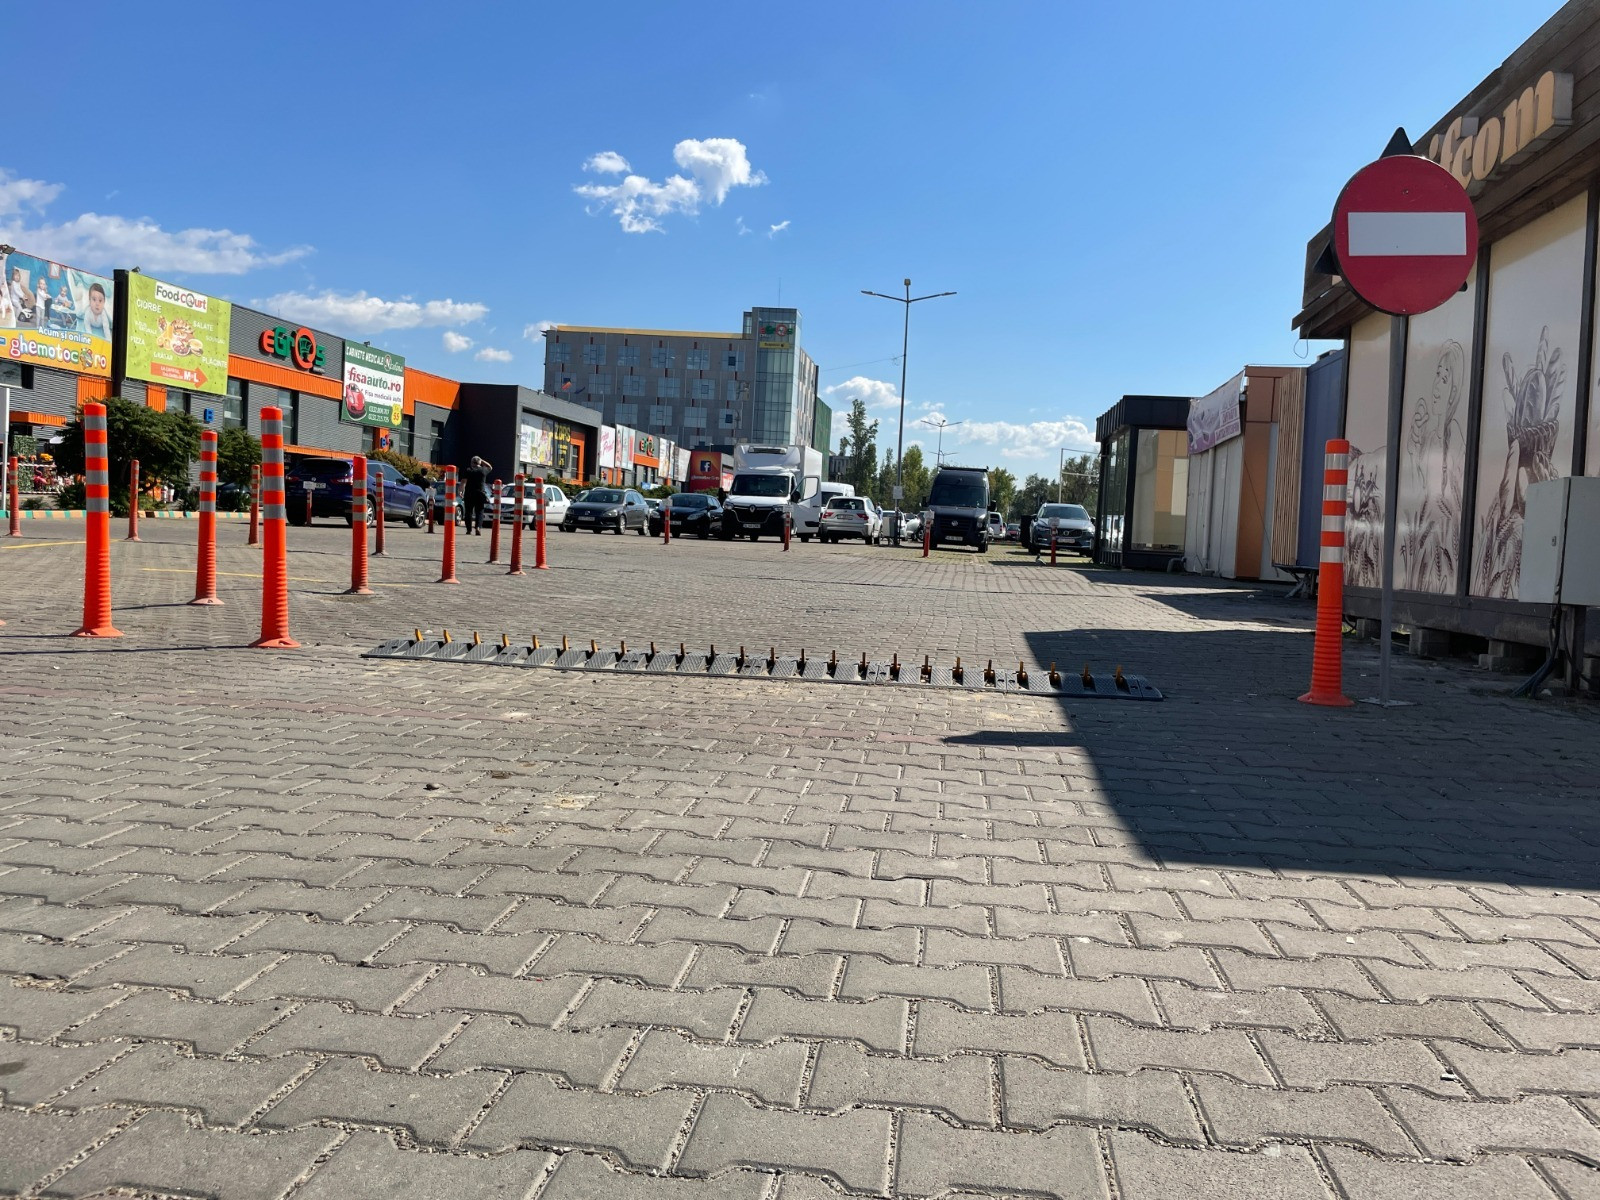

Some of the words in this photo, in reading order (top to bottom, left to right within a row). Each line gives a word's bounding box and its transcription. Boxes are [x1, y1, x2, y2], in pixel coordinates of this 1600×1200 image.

[38, 326, 59, 337] Acum
[68, 332, 91, 344] online
[193, 320, 214, 331] SALATE
[346, 346, 365, 360] CABINETE
[365, 352, 384, 366] MEDICALE
[348, 367, 401, 392] fisaauto.ro
